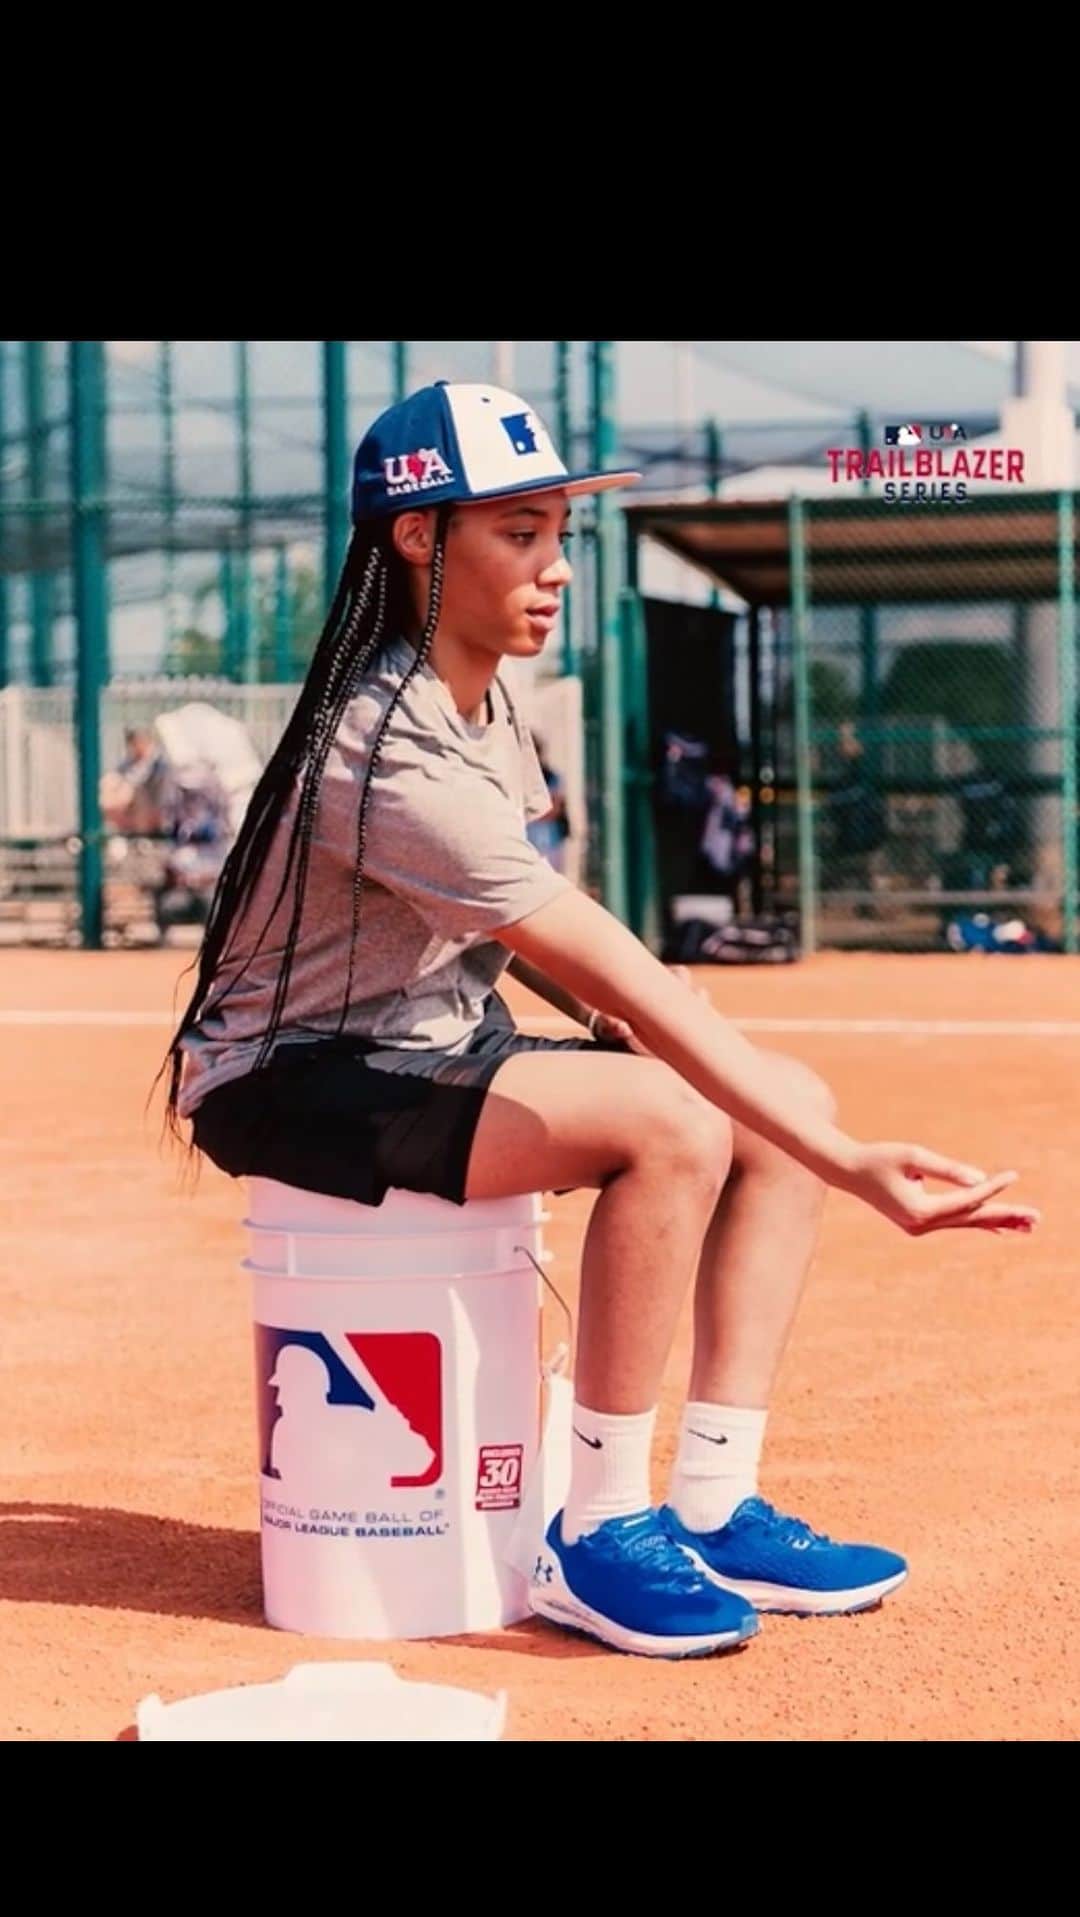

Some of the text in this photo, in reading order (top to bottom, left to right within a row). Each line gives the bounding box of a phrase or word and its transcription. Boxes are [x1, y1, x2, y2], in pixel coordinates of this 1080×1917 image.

[480, 1458, 519, 1487] 30
[309, 1508, 358, 1523] GAME
[364, 1511, 413, 1524] BALL
[419, 1509, 444, 1522] OF
[295, 1522, 350, 1537] LEAGUE
[355, 1524, 447, 1537] BASEBALL
